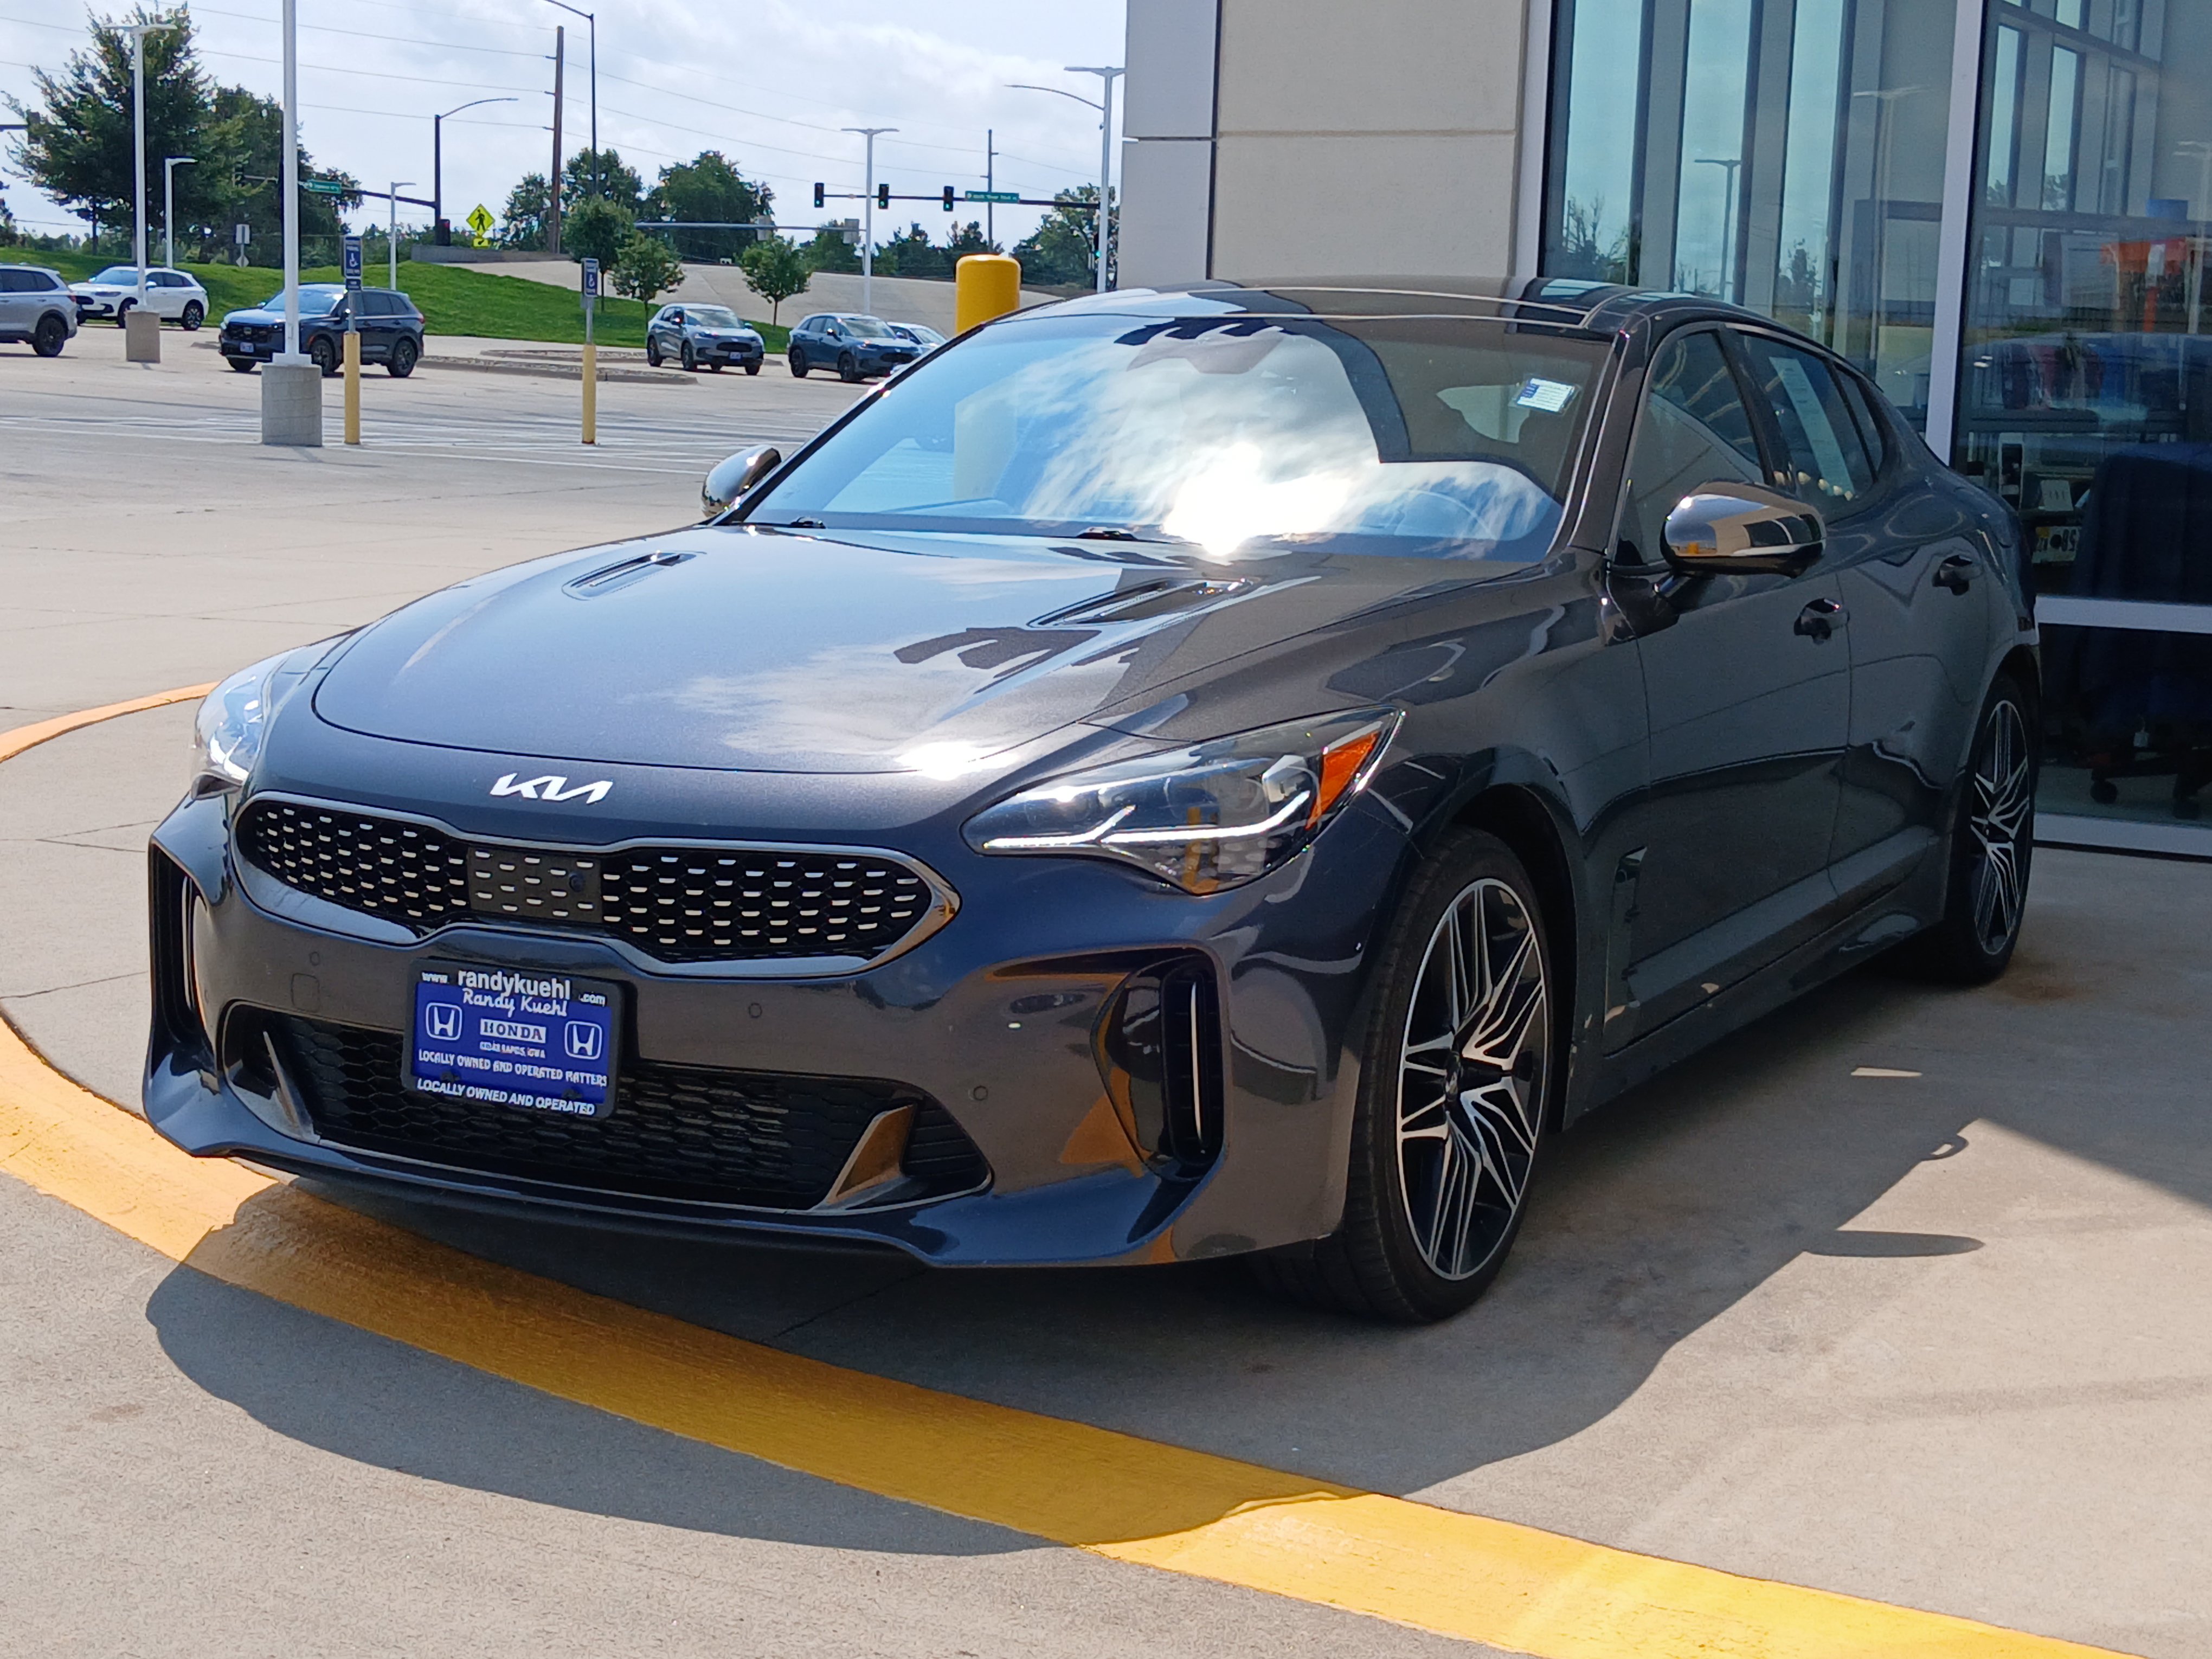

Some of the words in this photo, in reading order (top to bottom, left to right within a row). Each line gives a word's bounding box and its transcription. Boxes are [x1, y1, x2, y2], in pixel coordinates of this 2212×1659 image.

[490, 773, 613, 804] KIA
[458, 970, 570, 1000] randykuehl
[462, 988, 515, 1018] Randy
[520, 995, 567, 1017] Kuehl
[484, 1021, 543, 1041] HONDA
[419, 1049, 455, 1066] LOCALLY
[456, 1055, 491, 1070] OWNED
[515, 1063, 563, 1080] OPERATED
[417, 1078, 466, 1097] LOCALLY
[466, 1086, 508, 1103] OWNED
[508, 1092, 534, 1107] AND
[535, 1096, 595, 1116] OPERATED
